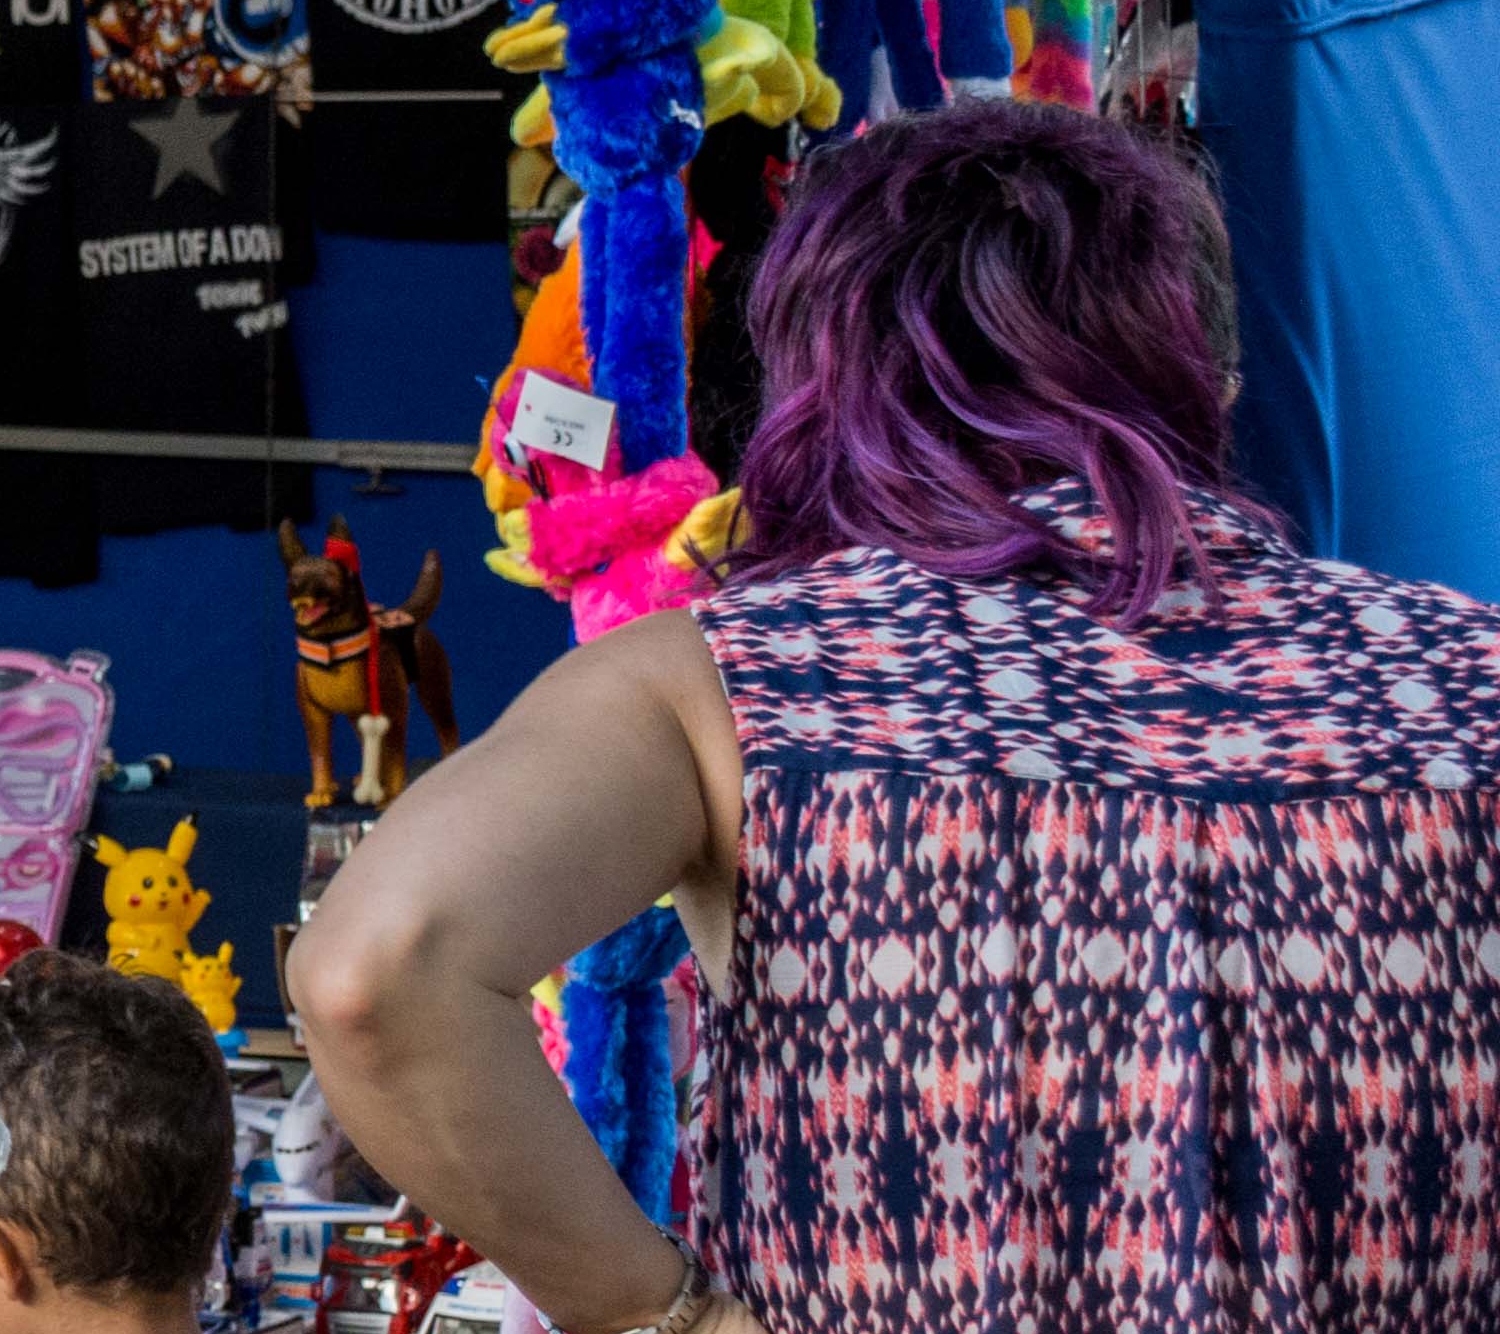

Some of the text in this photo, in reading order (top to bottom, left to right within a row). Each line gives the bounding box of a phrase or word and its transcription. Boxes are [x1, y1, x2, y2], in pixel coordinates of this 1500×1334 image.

[79, 230, 176, 279] SYSTEM
[177, 227, 208, 268] OF
[209, 226, 229, 265] A
